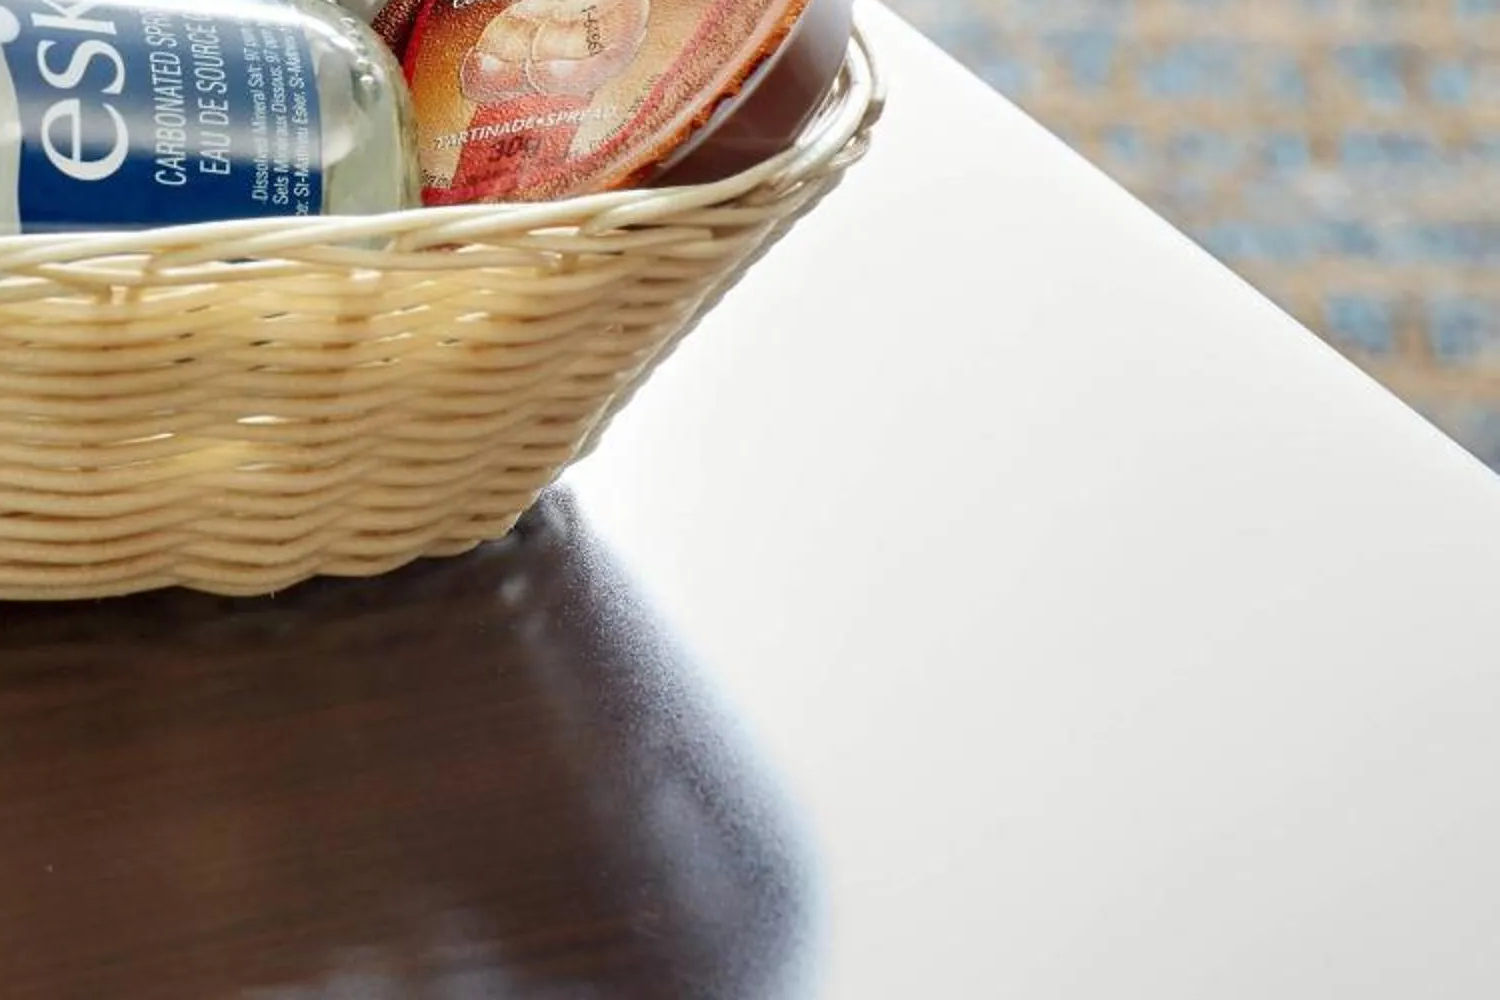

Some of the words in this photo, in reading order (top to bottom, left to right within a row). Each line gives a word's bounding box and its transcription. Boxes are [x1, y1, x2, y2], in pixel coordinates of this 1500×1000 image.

[185, 21, 228, 95] SOURCE
[149, 50, 188, 187] CARBONATED
[197, 97, 230, 126] DE
[199, 128, 232, 175] EAU
